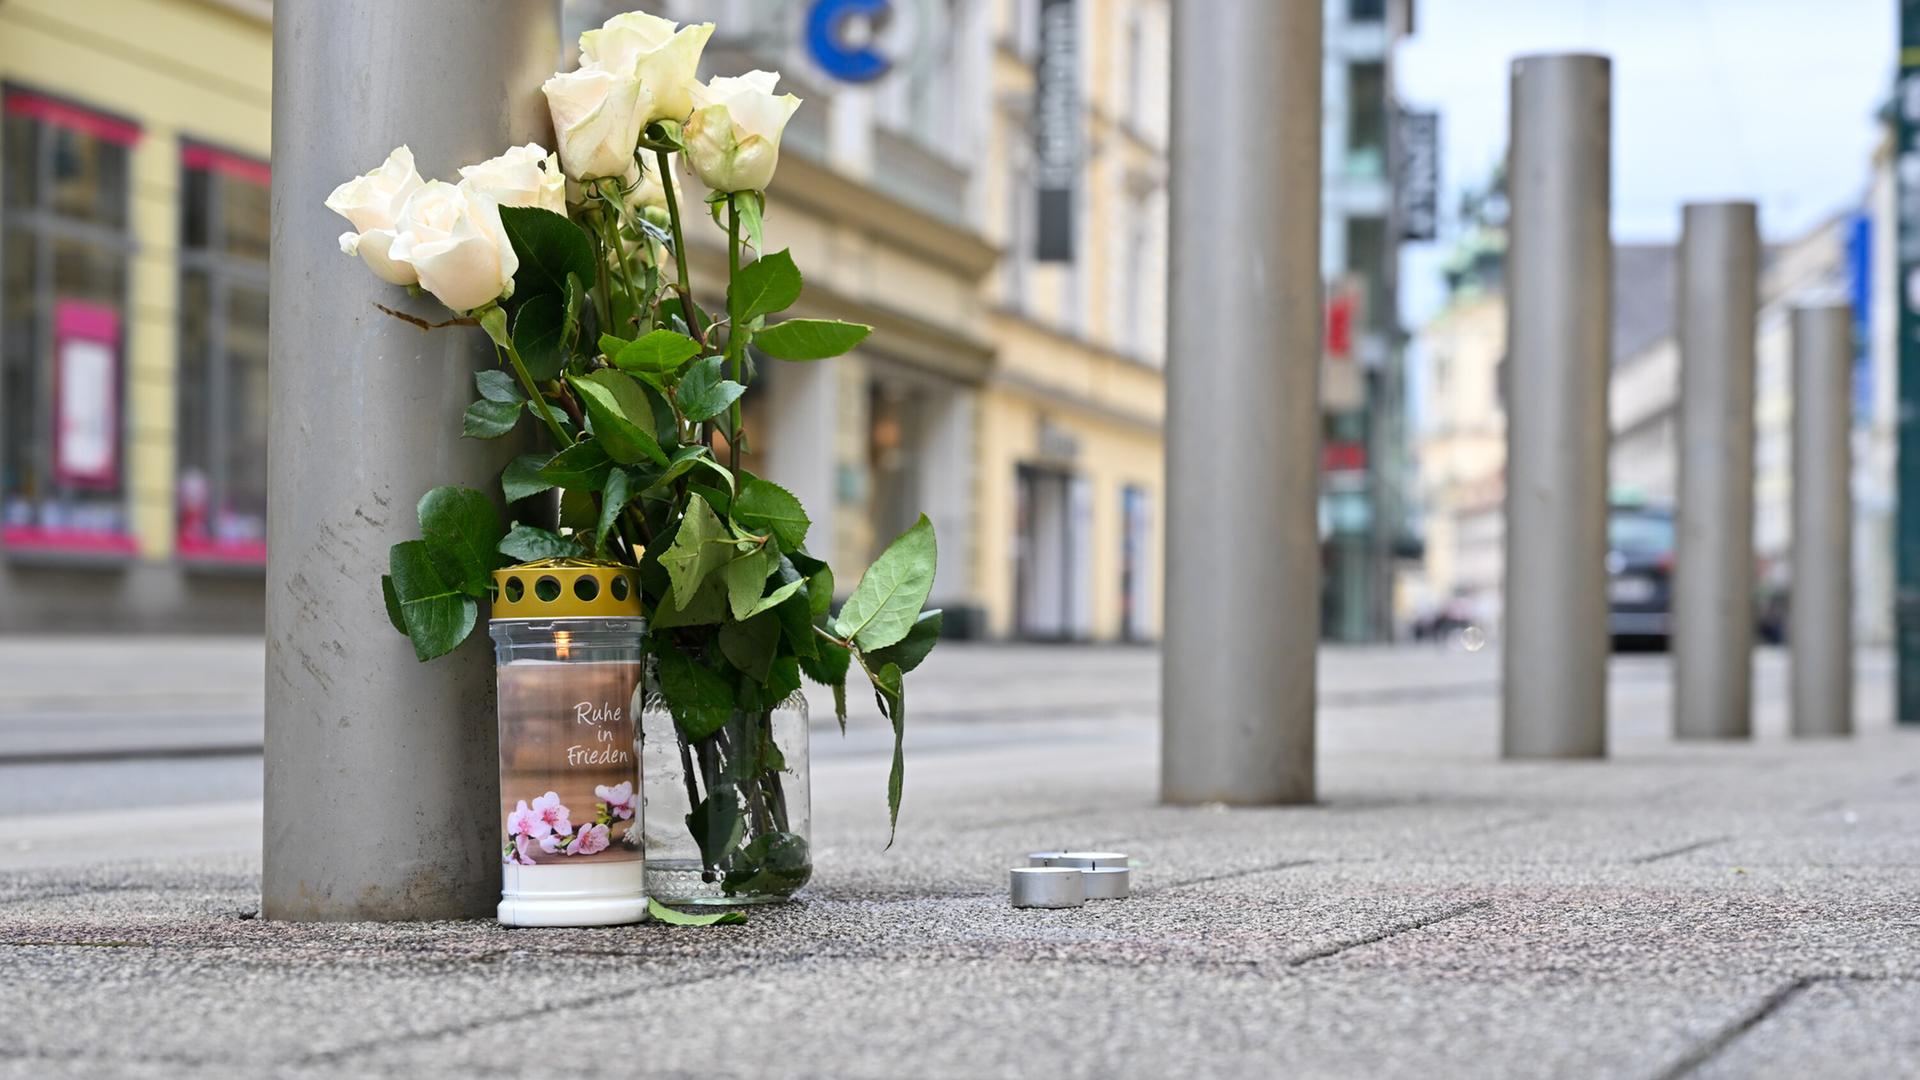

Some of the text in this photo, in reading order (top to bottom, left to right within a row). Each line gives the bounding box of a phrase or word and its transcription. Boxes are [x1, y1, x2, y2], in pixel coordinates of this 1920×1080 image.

[573, 701, 622, 725] Ruhe
[597, 725, 614, 742] in
[567, 743, 628, 767] Frieden
